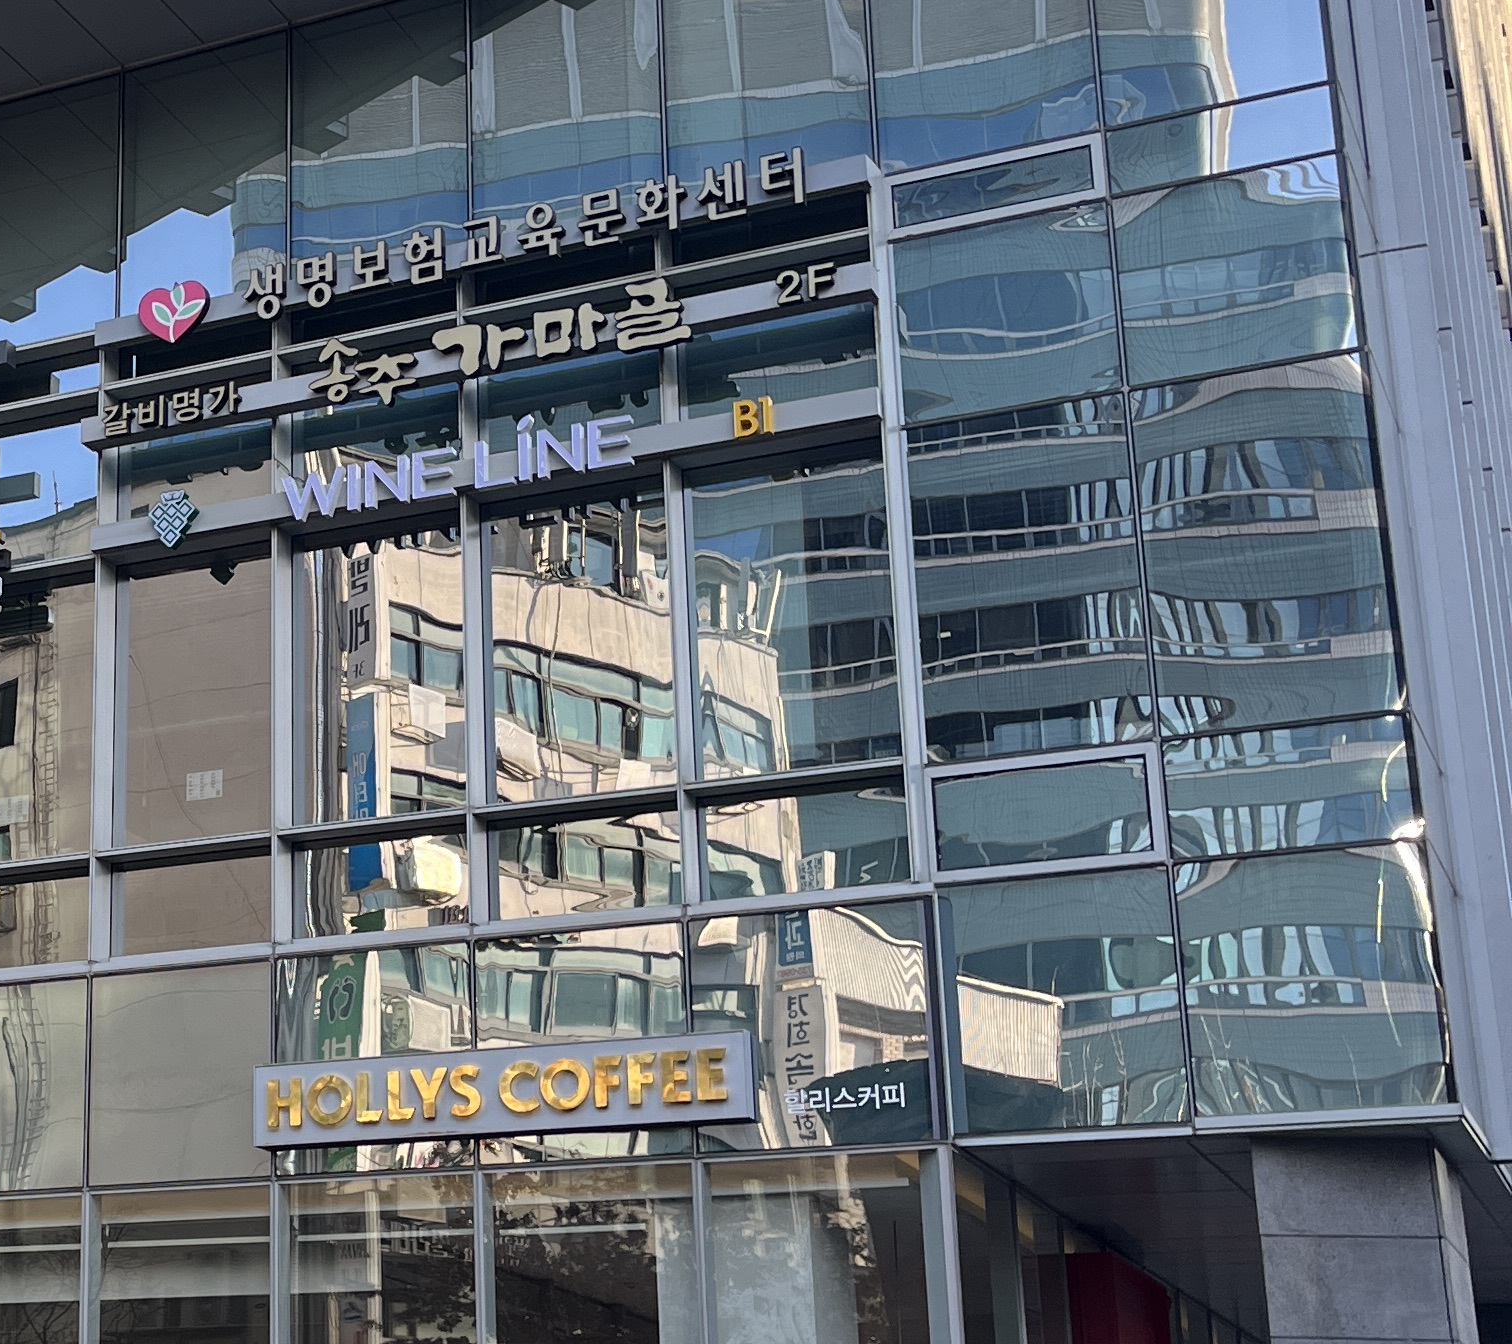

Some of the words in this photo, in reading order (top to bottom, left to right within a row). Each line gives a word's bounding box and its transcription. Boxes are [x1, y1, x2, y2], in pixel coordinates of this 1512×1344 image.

[243, 147, 806, 320] 생명보험교육문화센터
[776, 261, 836, 306] 2F
[309, 338, 418, 405] 송추
[432, 277, 691, 376] 가마골
[102, 381, 241, 437] 갈비명가
[732, 395, 776, 438] B1
[281, 446, 458, 523] WINE
[266, 1064, 482, 1129] HOLLYS
[498, 1047, 729, 1112] COFFEE
[783, 1082, 906, 1114] 할리스커피
